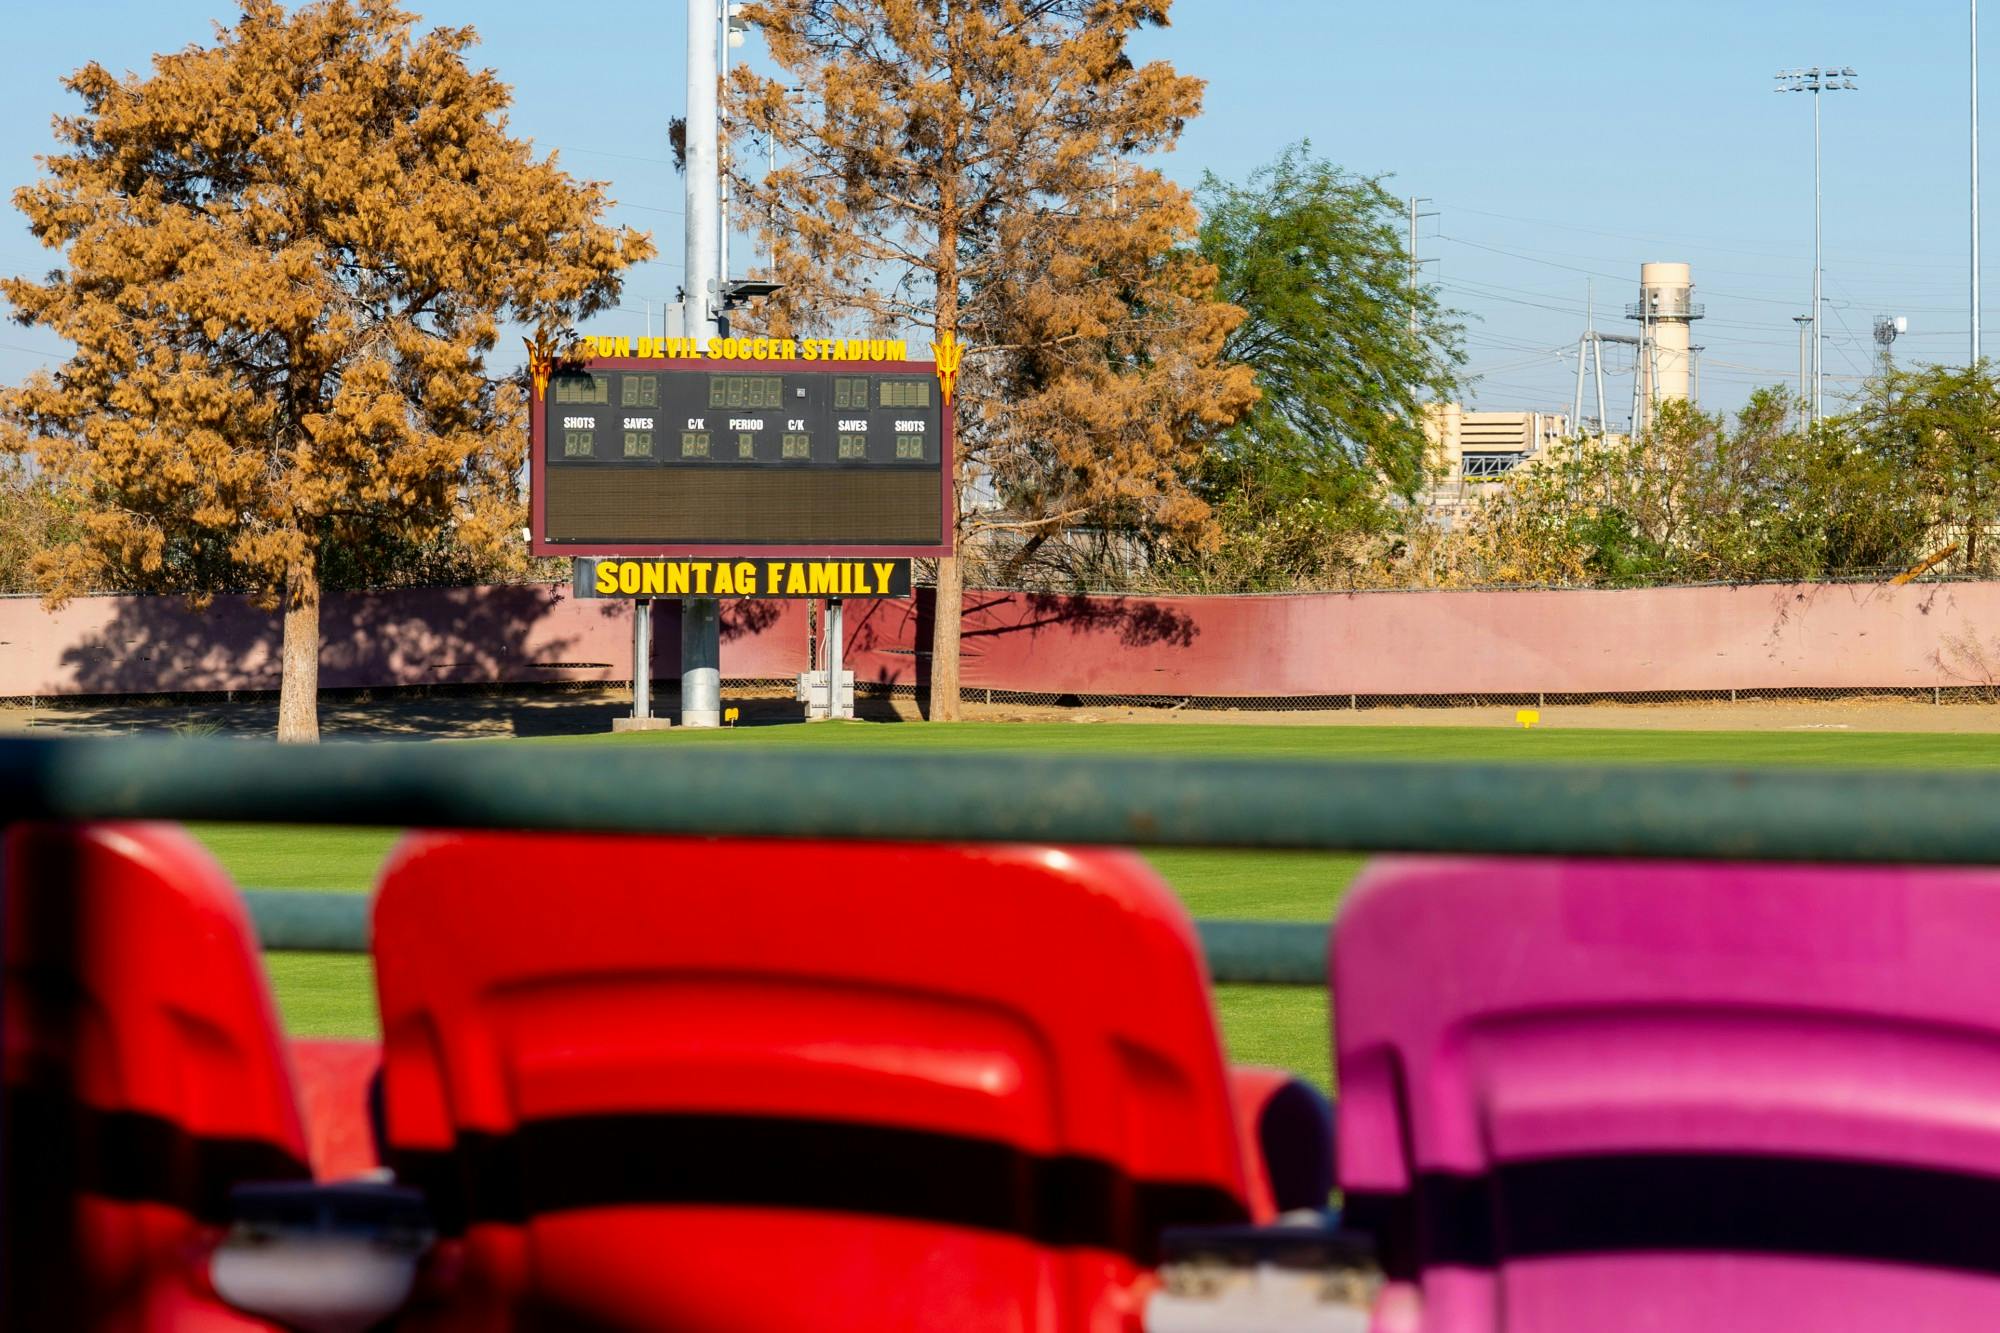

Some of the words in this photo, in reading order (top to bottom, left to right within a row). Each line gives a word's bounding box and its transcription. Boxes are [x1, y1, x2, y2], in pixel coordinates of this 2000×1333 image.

[637, 336, 702, 359] DEVIL
[707, 337, 795, 360] SOCCER
[801, 339, 907, 361] STADIUM
[563, 416, 596, 429] SHOTS
[623, 417, 654, 430] SAVES
[688, 418, 705, 430] C/K
[729, 418, 764, 431] PERIOD
[788, 418, 804, 431] C/K
[838, 419, 868, 432] SAVES
[894, 419, 925, 432] SHOTS
[595, 561, 757, 595] SONNTAG
[766, 562, 894, 594] FAMILY
